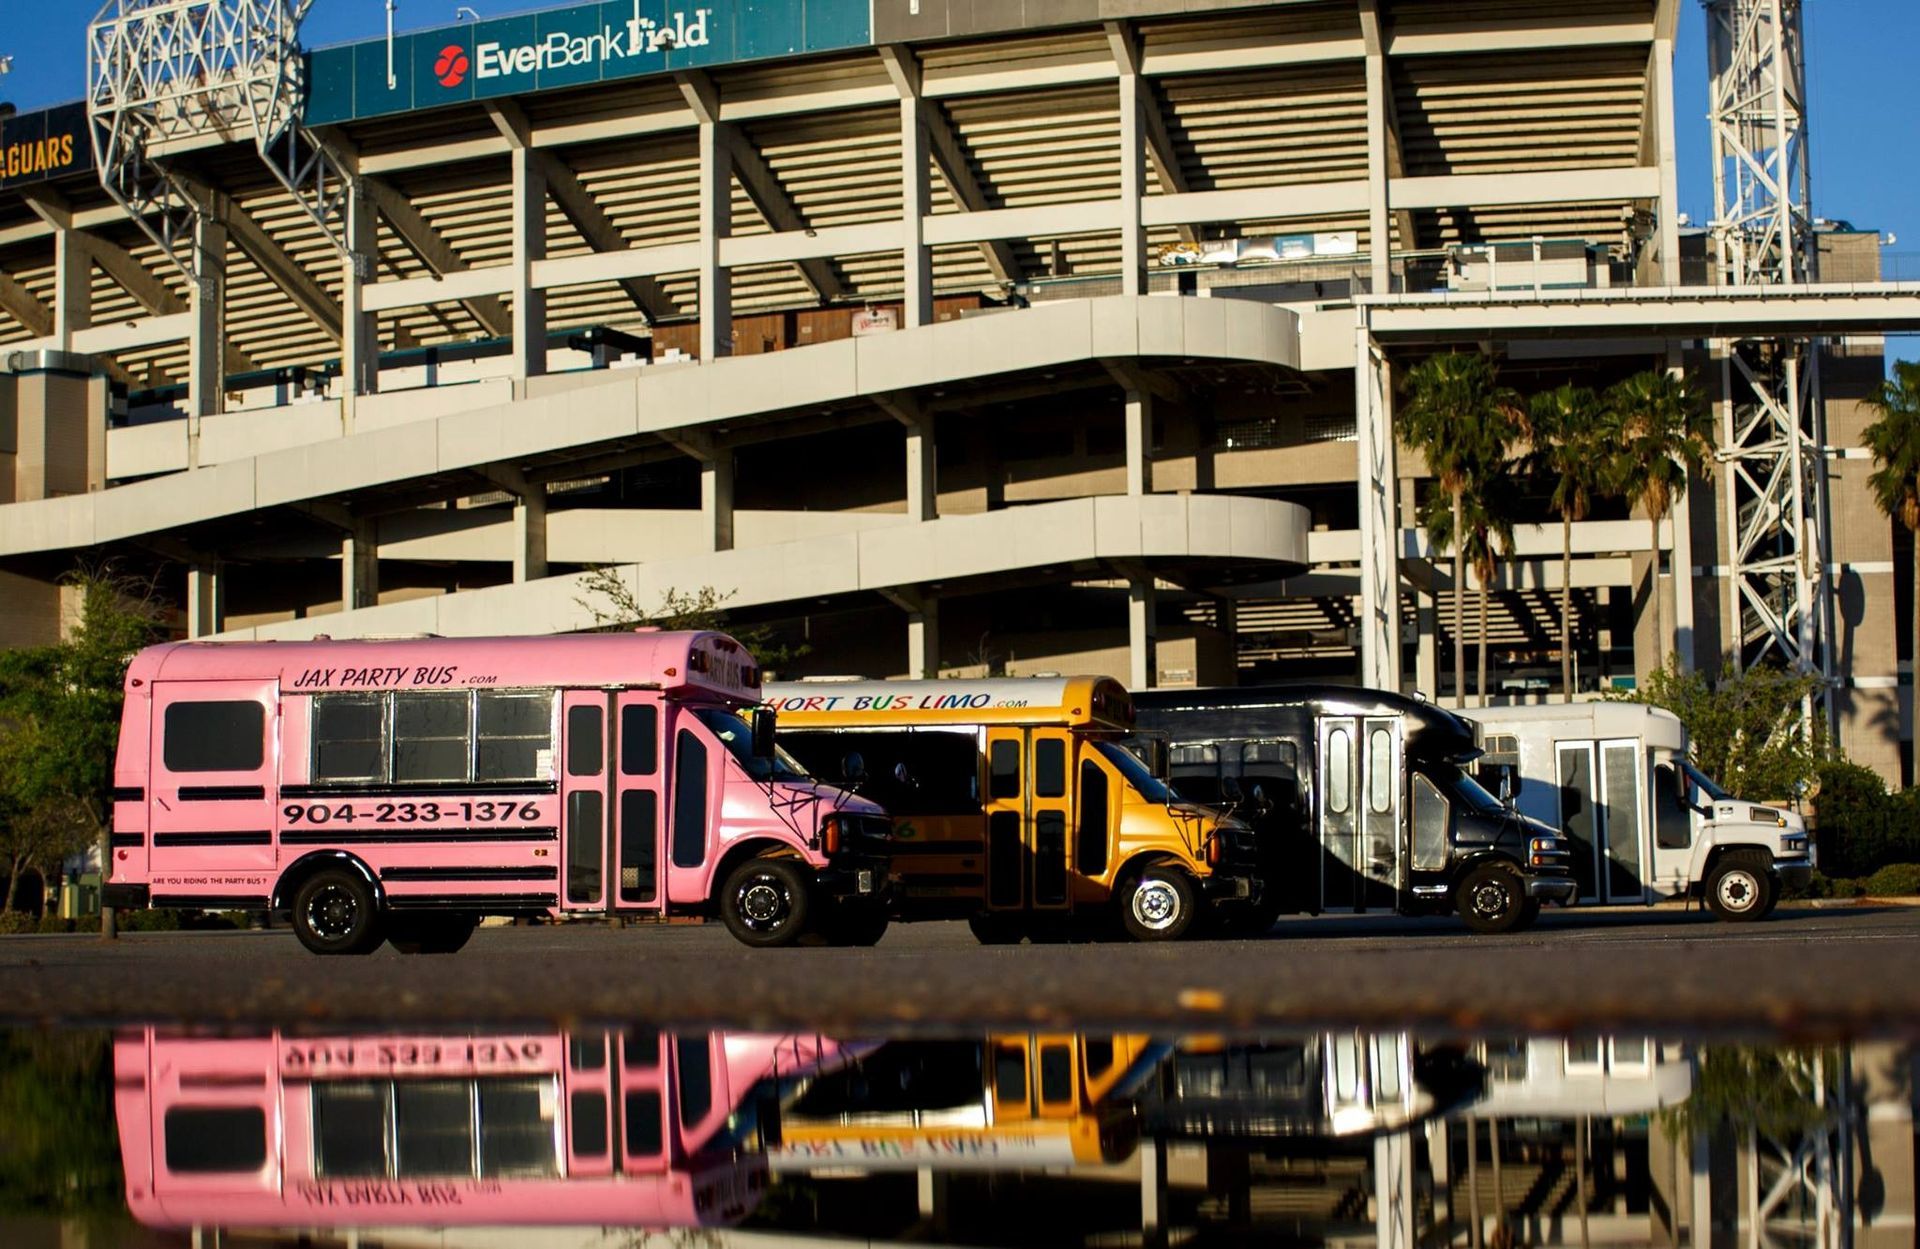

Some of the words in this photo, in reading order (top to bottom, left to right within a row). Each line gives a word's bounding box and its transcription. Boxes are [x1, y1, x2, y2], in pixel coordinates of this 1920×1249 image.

[476, 25, 631, 79] EverBank
[294, 669, 336, 687] JAX
[340, 667, 409, 687] PARTY
[412, 666, 458, 685] BUS
[764, 696, 844, 711] HORT
[853, 695, 913, 710] BUS
[919, 693, 991, 709] LIMO
[283, 801, 541, 824] 904-233-1376
[167, 877, 181, 885] YOU
[210, 877, 222, 885] THE
[224, 877, 245, 885] PARTY
